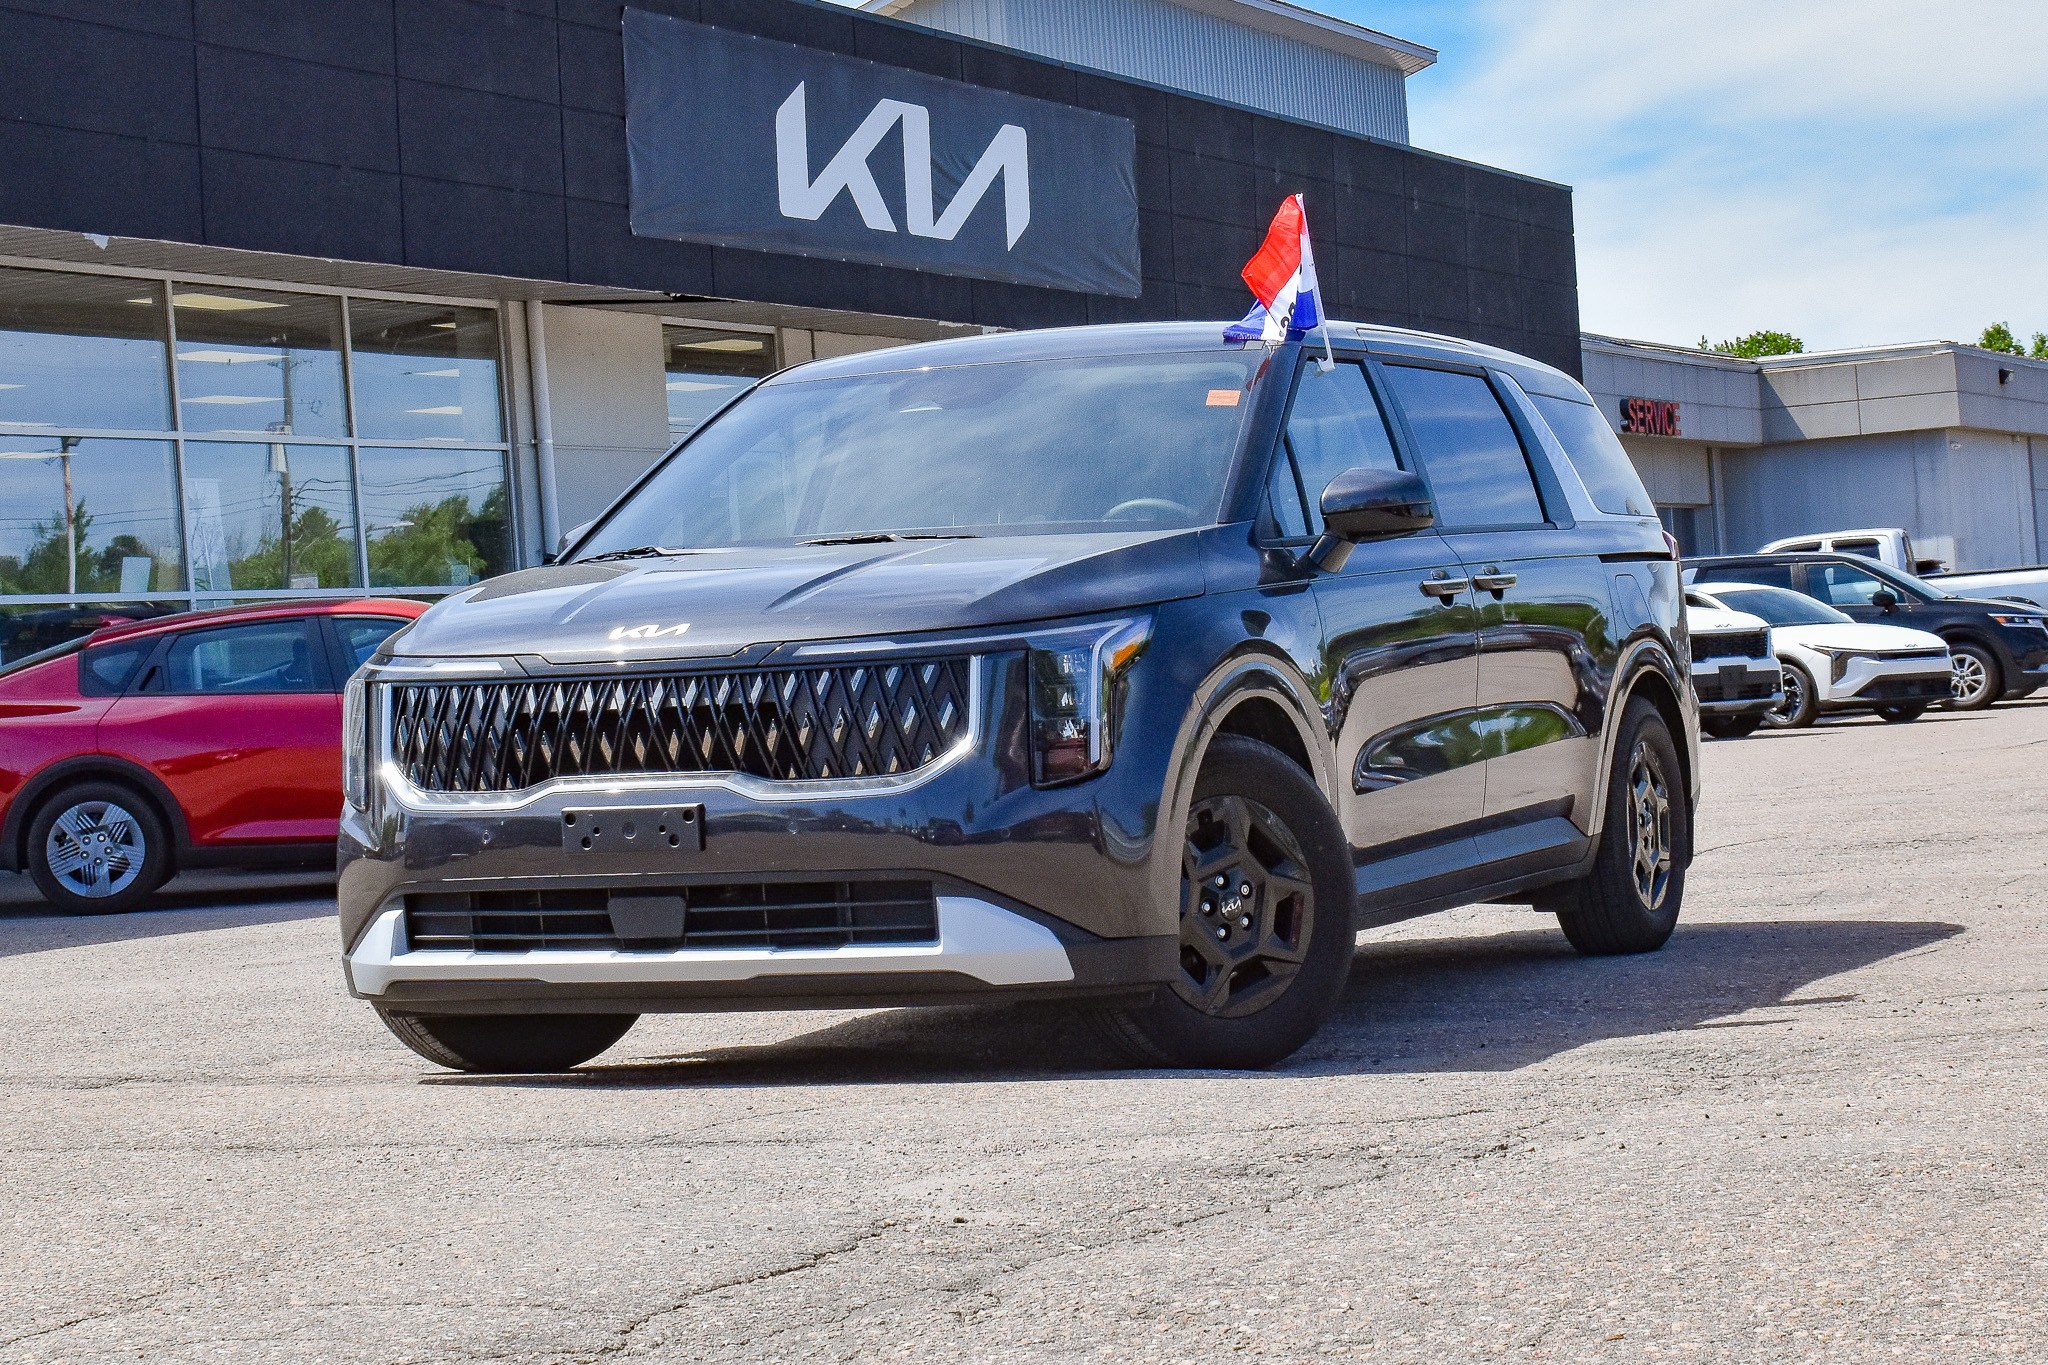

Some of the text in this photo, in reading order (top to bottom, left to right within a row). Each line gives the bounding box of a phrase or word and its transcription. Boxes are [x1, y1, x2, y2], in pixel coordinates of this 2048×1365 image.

[776, 80, 1030, 252] KIA
[1624, 398, 1681, 436] SERVICE
[608, 623, 692, 640] KIA
[1221, 898, 1241, 914] KIA
